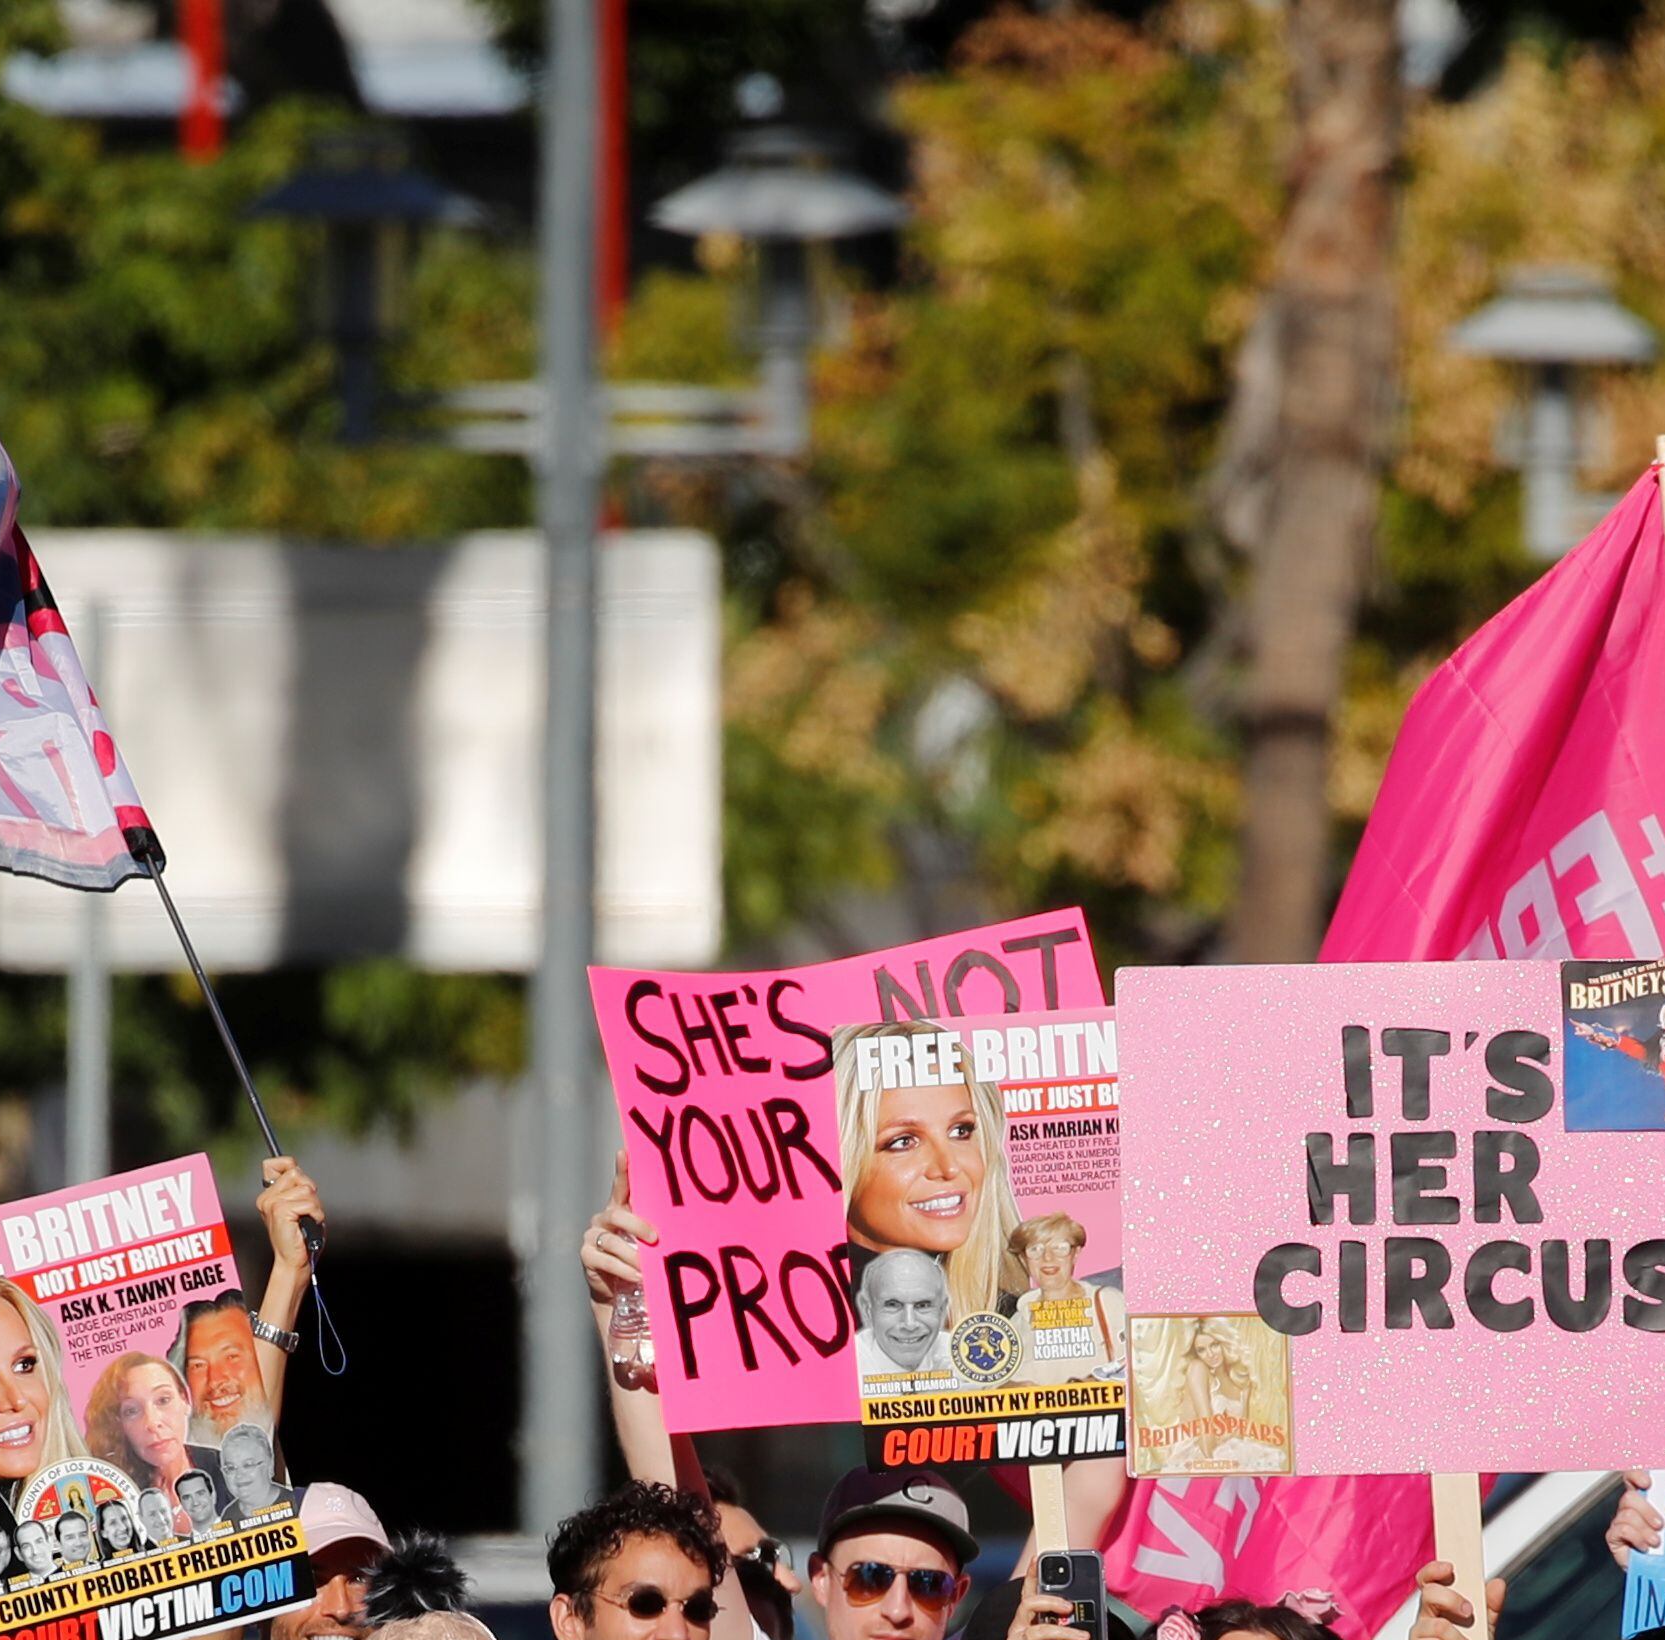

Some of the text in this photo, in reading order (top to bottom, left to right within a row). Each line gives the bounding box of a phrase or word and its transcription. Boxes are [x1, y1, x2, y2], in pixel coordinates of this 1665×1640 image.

[1599, 971, 1621, 983] FINAL
[1623, 966, 1637, 977] ACT
[624, 926, 1081, 1097] SHE'S NOT
[855, 1020, 1118, 1091] FREE BRITN
[1341, 1025, 1555, 1124] IT'S
[1003, 1089, 1043, 1113] NOT
[1047, 1084, 1095, 1110] JUST
[1010, 1123, 1040, 1141] ASK
[1042, 1119, 1102, 1139] MARIAN
[1010, 1143, 1031, 1152] WAS
[1032, 1139, 1076, 1151] CHEATED
[1078, 1138, 1090, 1148] BY
[1092, 1136, 1112, 1147] FIVE
[629, 1097, 843, 1207] YOUR
[1011, 1151, 1065, 1164] GUARDIANS
[1066, 1150, 1074, 1159] &
[1012, 1164, 1034, 1175] WHO
[1036, 1161, 1090, 1173] LIQUIDATED
[1092, 1159, 1111, 1169] HER
[1012, 1176, 1027, 1186] VIA
[1030, 1174, 1059, 1185] LEGAL
[1014, 1181, 1116, 1197] JUDICIAL MISCONDUCT
[1306, 1131, 1544, 1227] HER
[1, 1171, 197, 1270] BRITNEY
[33, 1229, 215, 1300] NOT JUST BRITNEY
[60, 1298, 96, 1324] ASK
[115, 1275, 178, 1310] TAWNY
[181, 1263, 227, 1293] GAGE
[66, 1299, 178, 1337] JUDGE CHRISTIAN DID
[68, 1317, 164, 1350] NOT OBEY LAW OR
[72, 1340, 128, 1363] THE TRUST
[1034, 1342, 1096, 1361] KORNICKI
[1036, 1327, 1091, 1345] BERTHA
[863, 1378, 959, 1394] ARTHUR DIAMOND
[868, 1399, 936, 1420] NASSAU
[939, 1394, 1006, 1416] COUNTY
[1009, 1391, 1031, 1411] NY
[1034, 1385, 1110, 1409] PROBATE
[21, 1462, 131, 1519] COUNTY OF LOS ANGELES
[85, 1560, 177, 1603] PROBATE
[180, 1524, 299, 1574] PREDATORS
